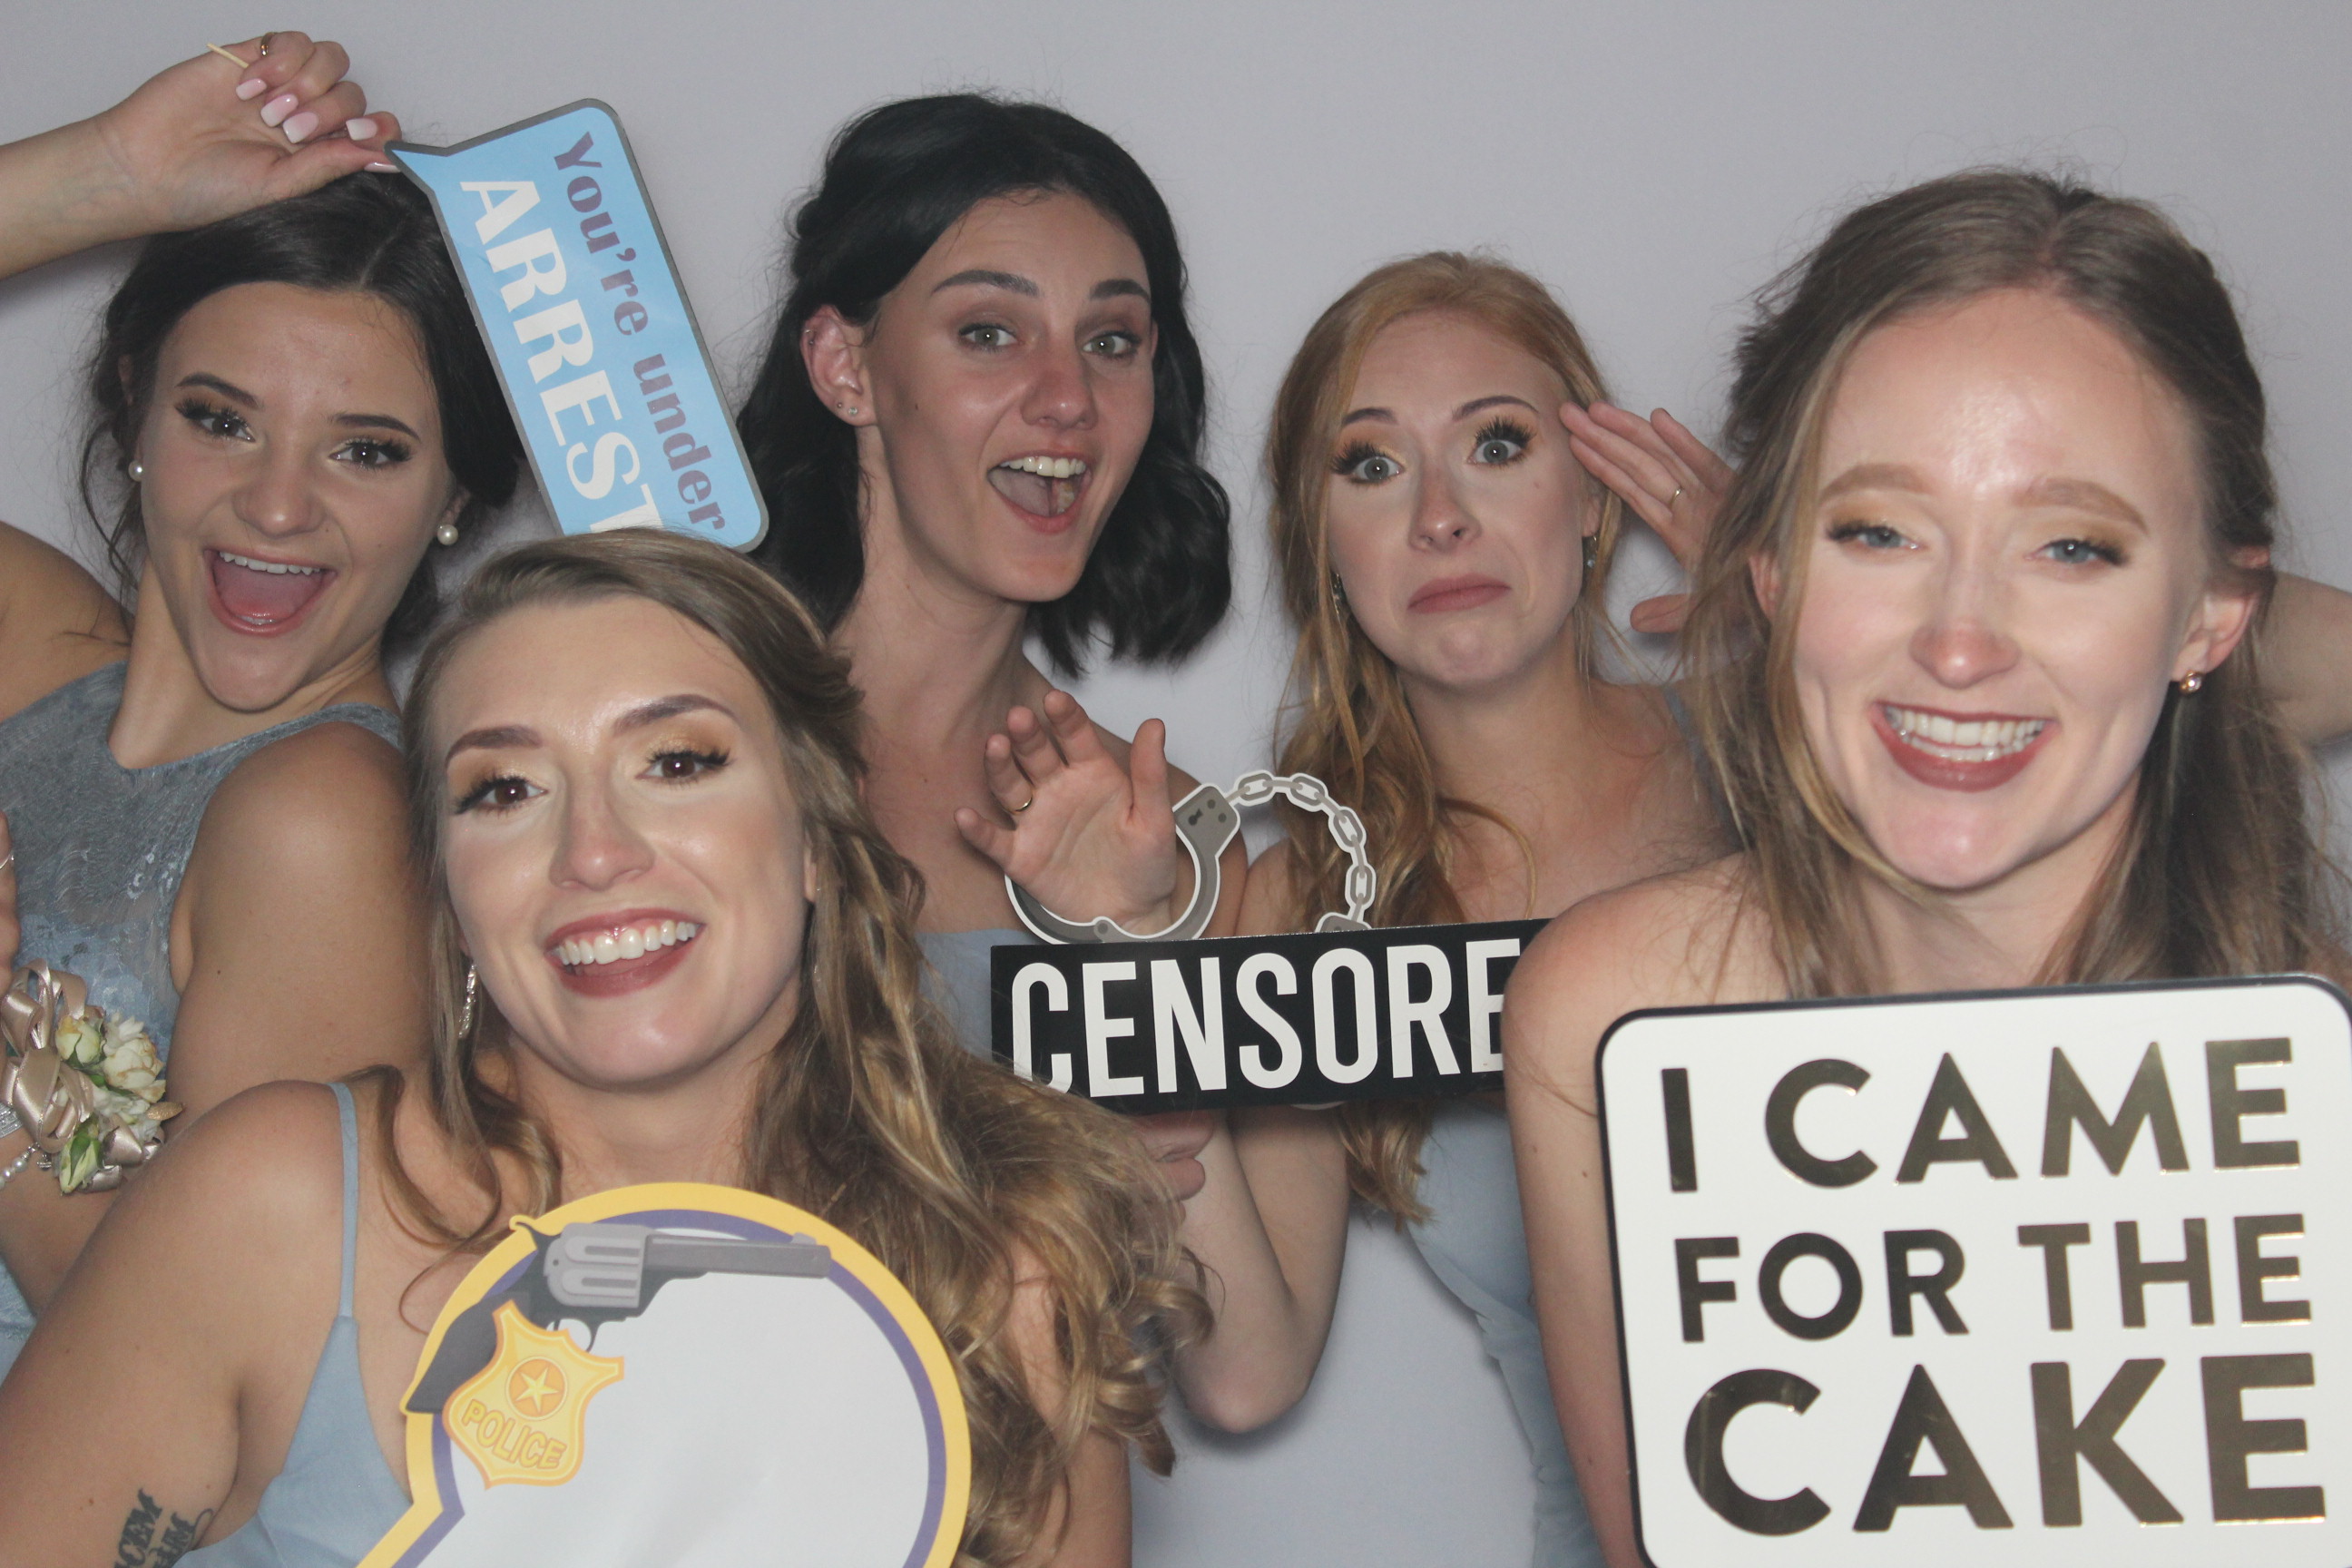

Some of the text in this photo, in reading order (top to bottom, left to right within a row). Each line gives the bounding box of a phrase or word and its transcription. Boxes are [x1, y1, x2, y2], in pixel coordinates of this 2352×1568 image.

[459, 180, 665, 534] ARREST
[632, 352, 727, 531] under
[1011, 937, 1522, 1099] CENSORE
[1661, 1037, 2301, 1193] I CAME
[1674, 1213, 2313, 1344] FOR THE
[462, 1399, 567, 1469] POLICE
[1684, 1353, 2327, 1537] CAKE
